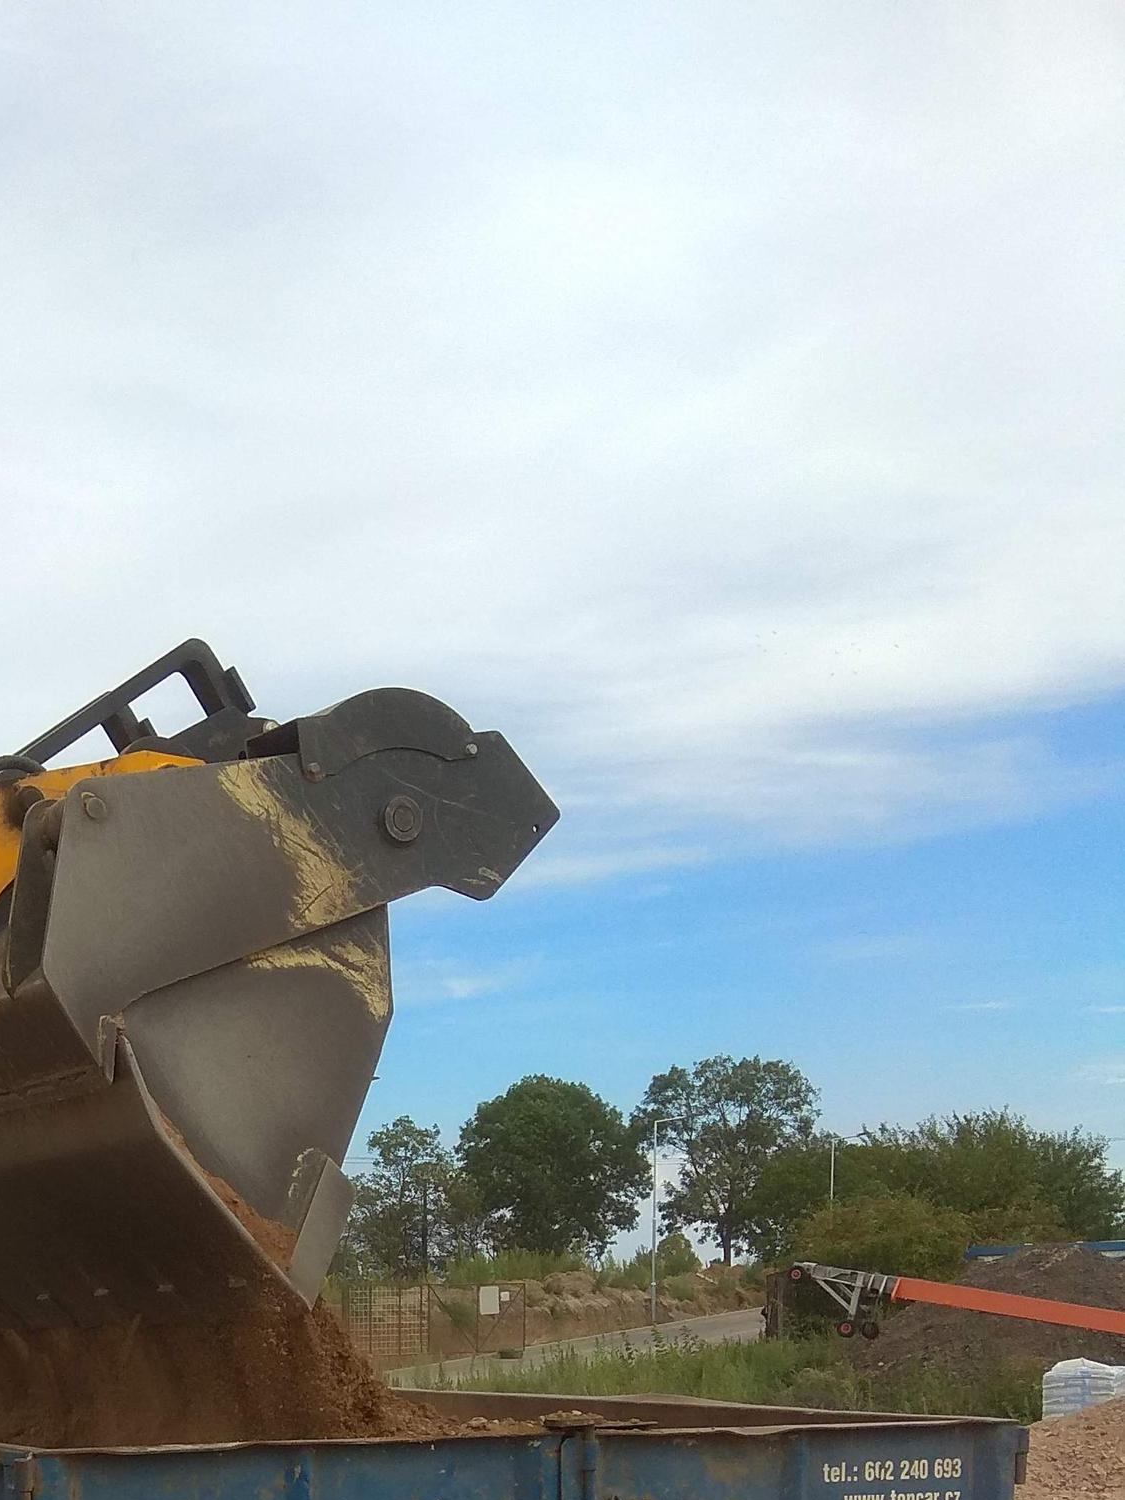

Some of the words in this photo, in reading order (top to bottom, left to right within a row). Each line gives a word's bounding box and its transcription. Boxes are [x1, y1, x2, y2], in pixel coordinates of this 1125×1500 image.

[823, 1462, 858, 1483] tel.:
[864, 1460, 895, 1482] 602
[900, 1459, 929, 1480] 240
[934, 1458, 962, 1479] 693
